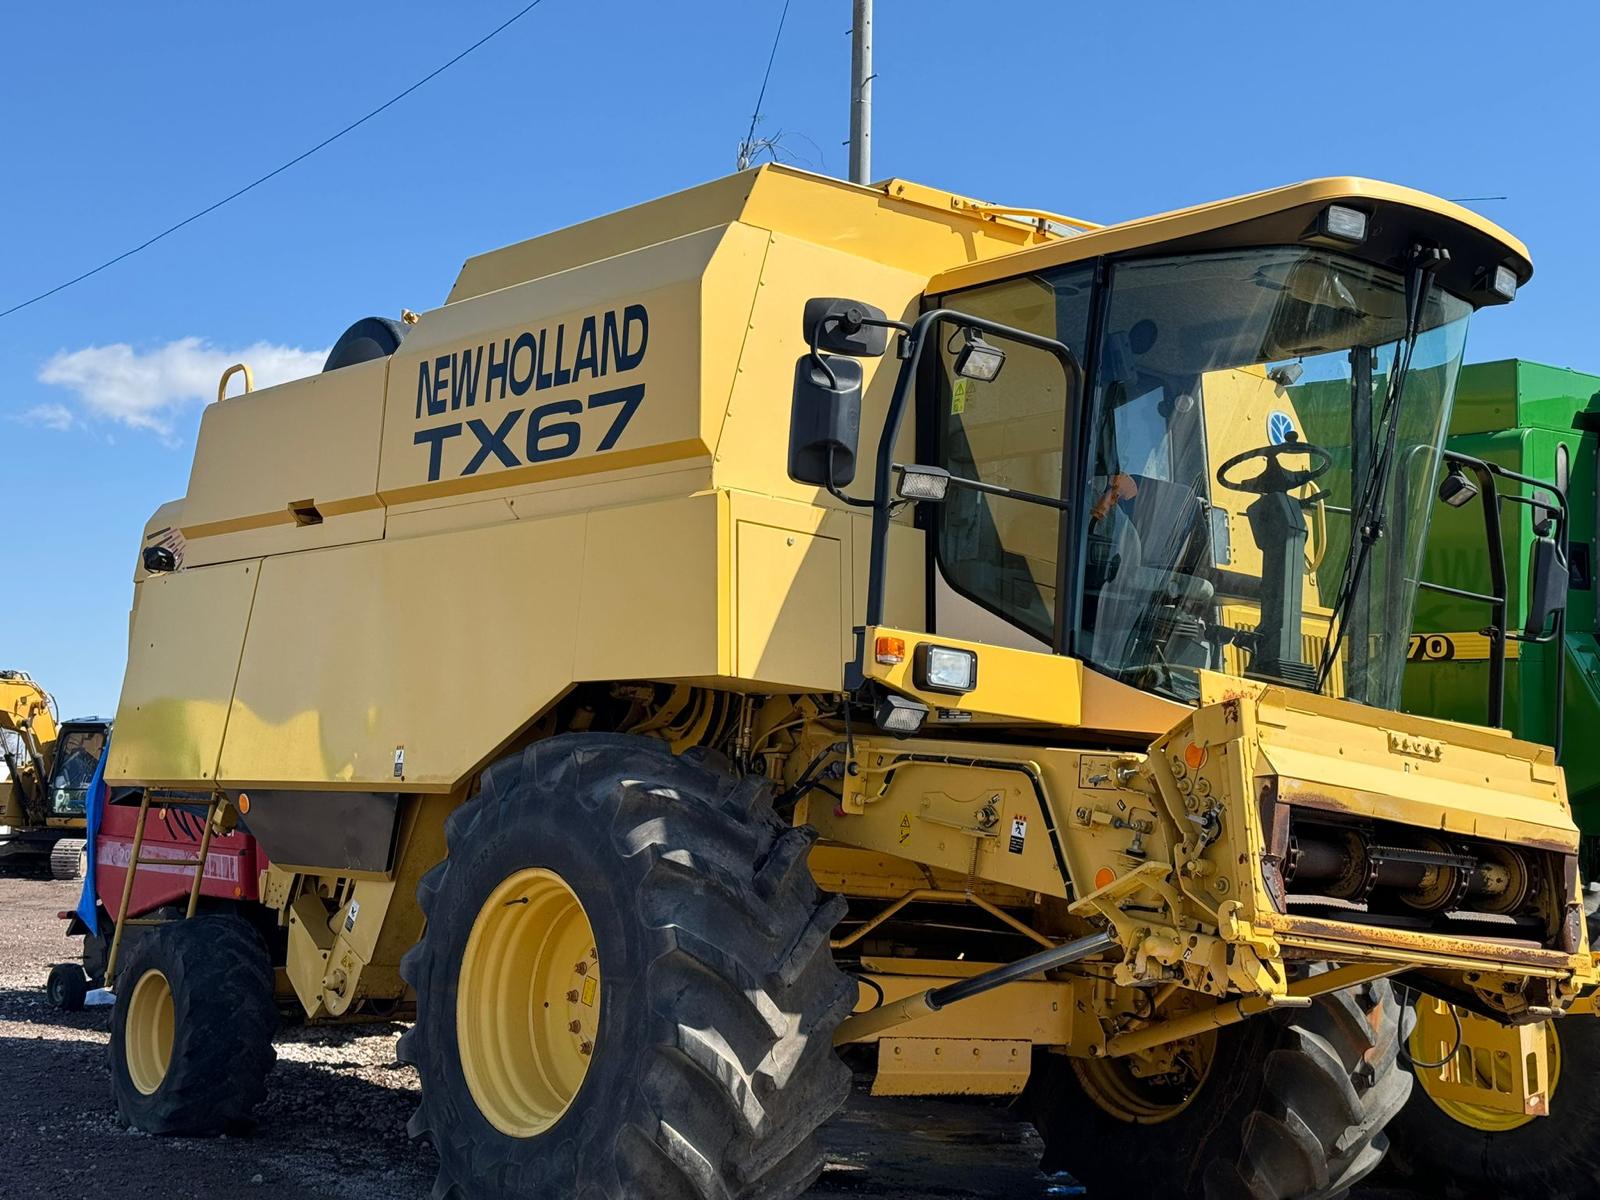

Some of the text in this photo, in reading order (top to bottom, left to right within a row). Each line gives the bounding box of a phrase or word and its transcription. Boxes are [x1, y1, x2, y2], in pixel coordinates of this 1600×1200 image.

[415, 303, 649, 420] NEW HOLLAND
[413, 382, 646, 482] TX67
